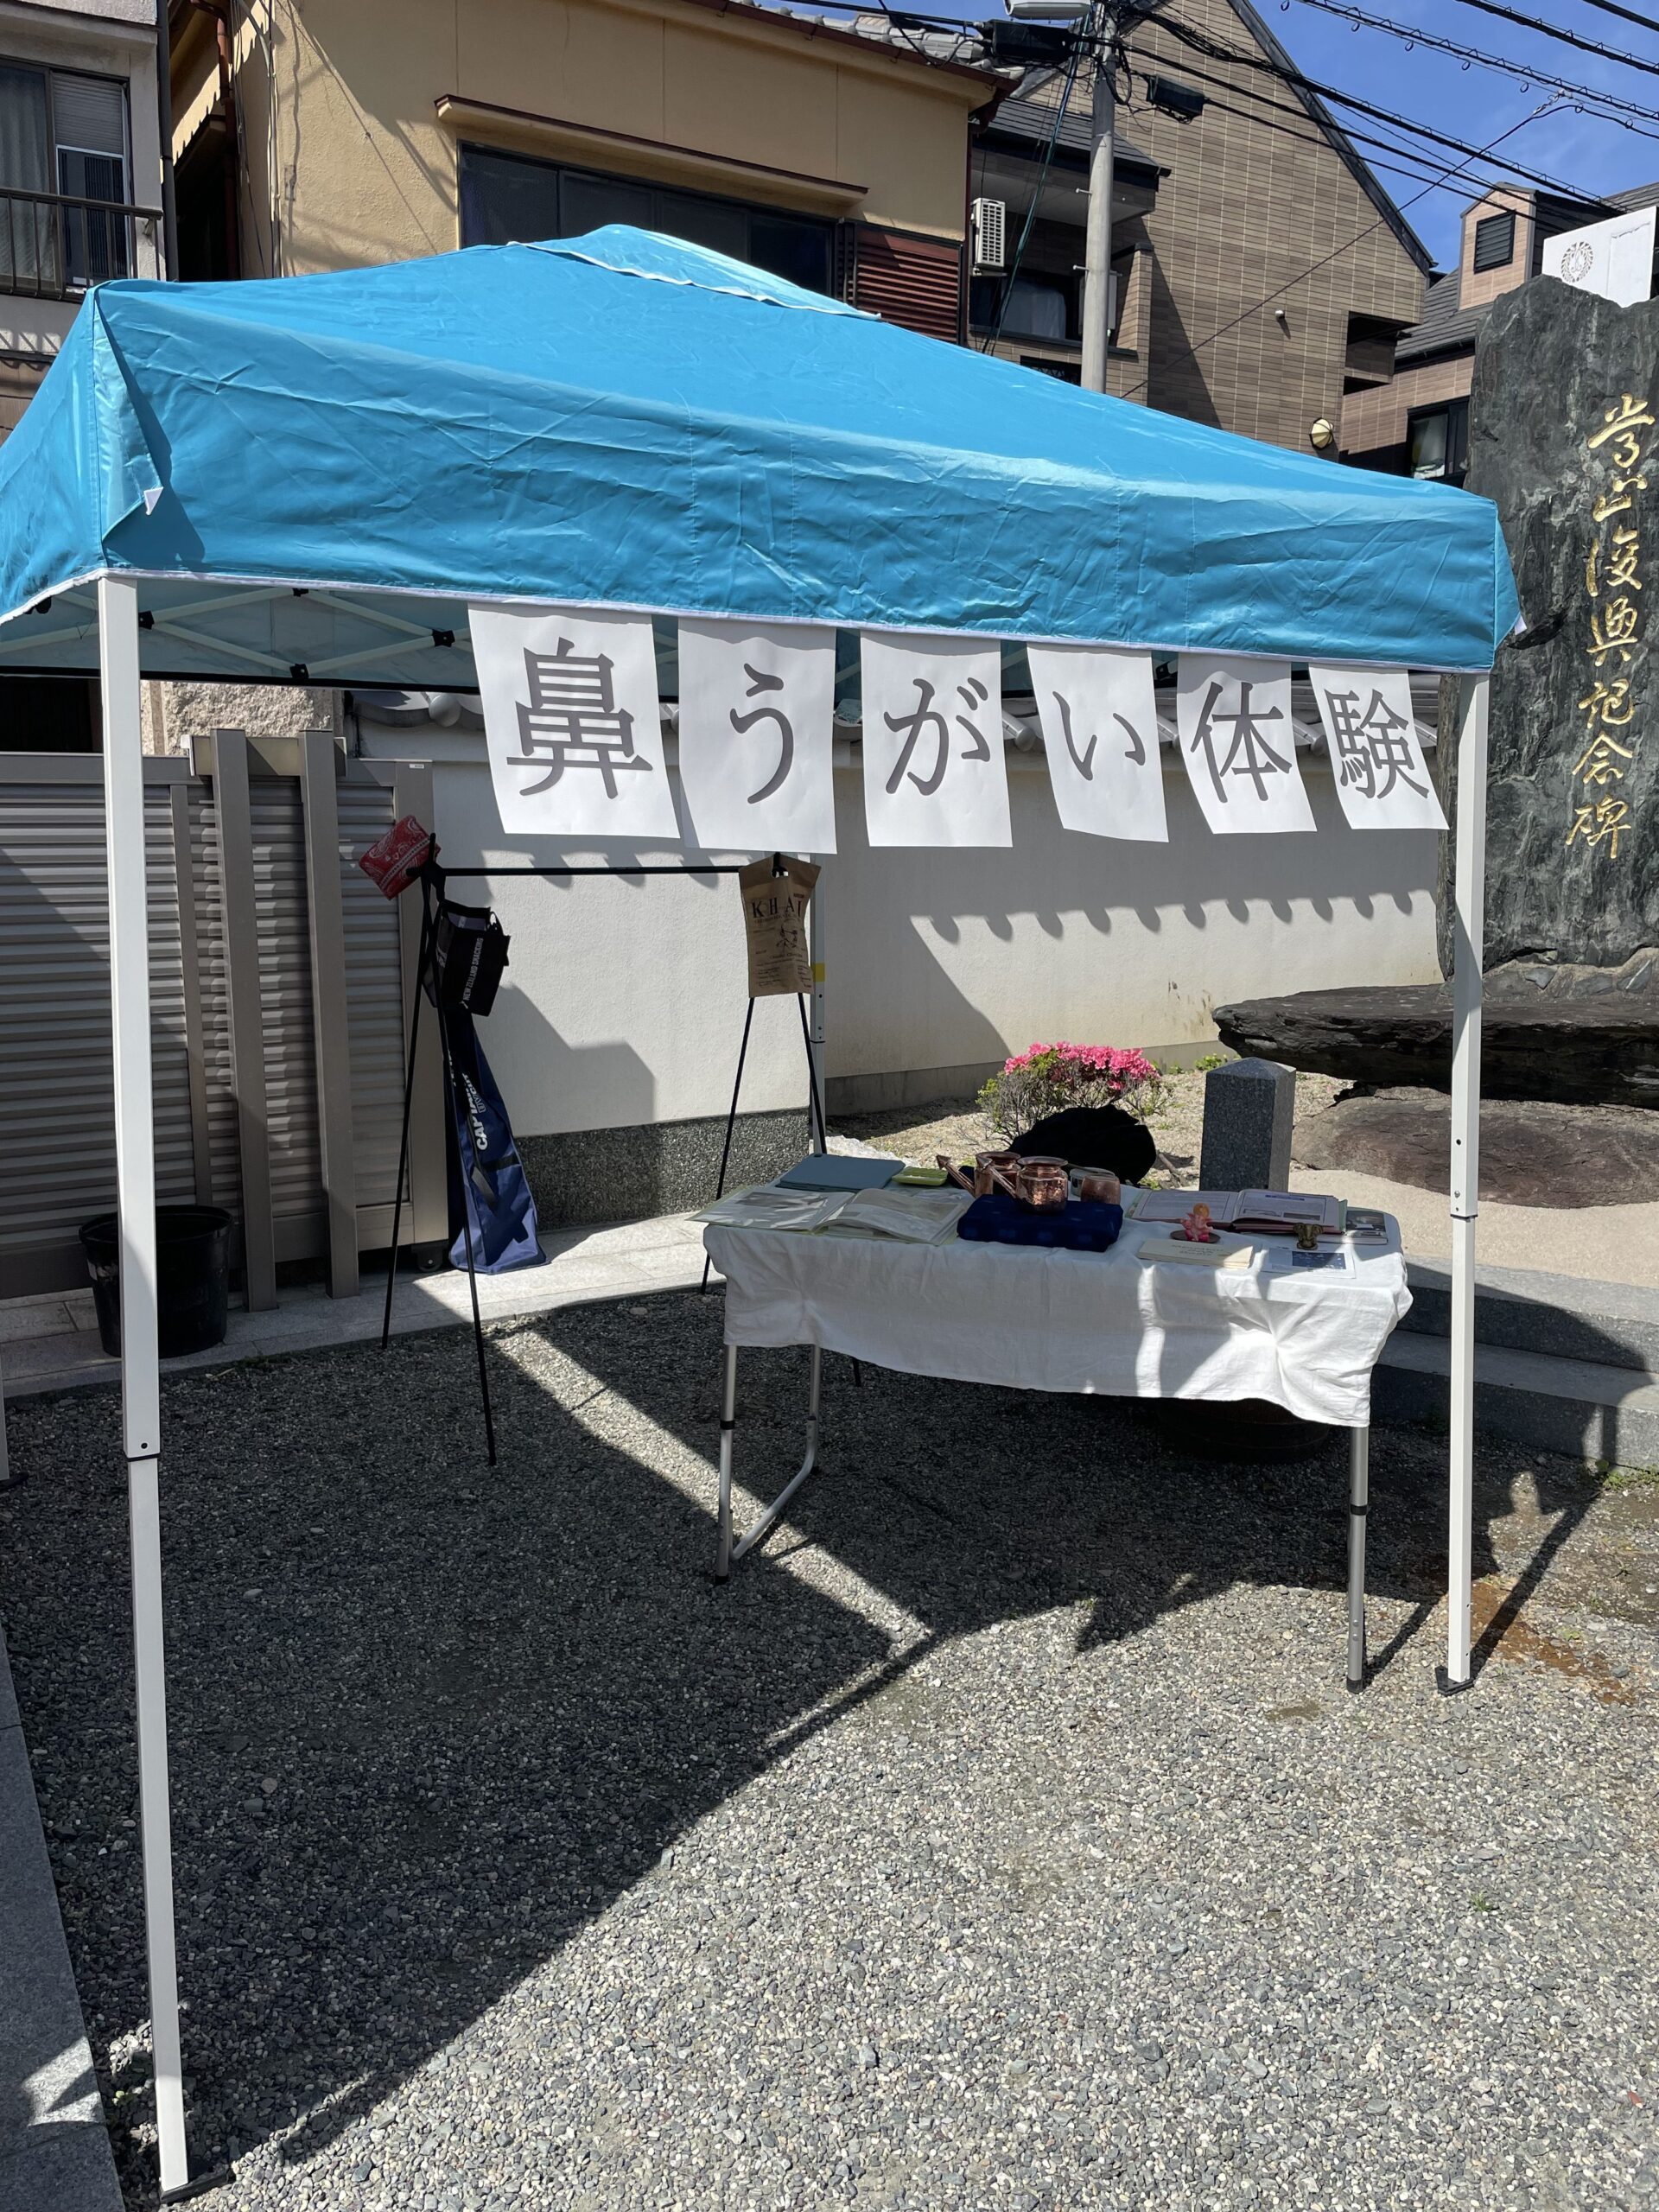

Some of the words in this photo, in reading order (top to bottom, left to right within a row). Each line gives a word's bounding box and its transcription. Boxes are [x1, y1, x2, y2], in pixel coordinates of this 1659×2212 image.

[506, 637, 1429, 804] 鼻うがい体験
